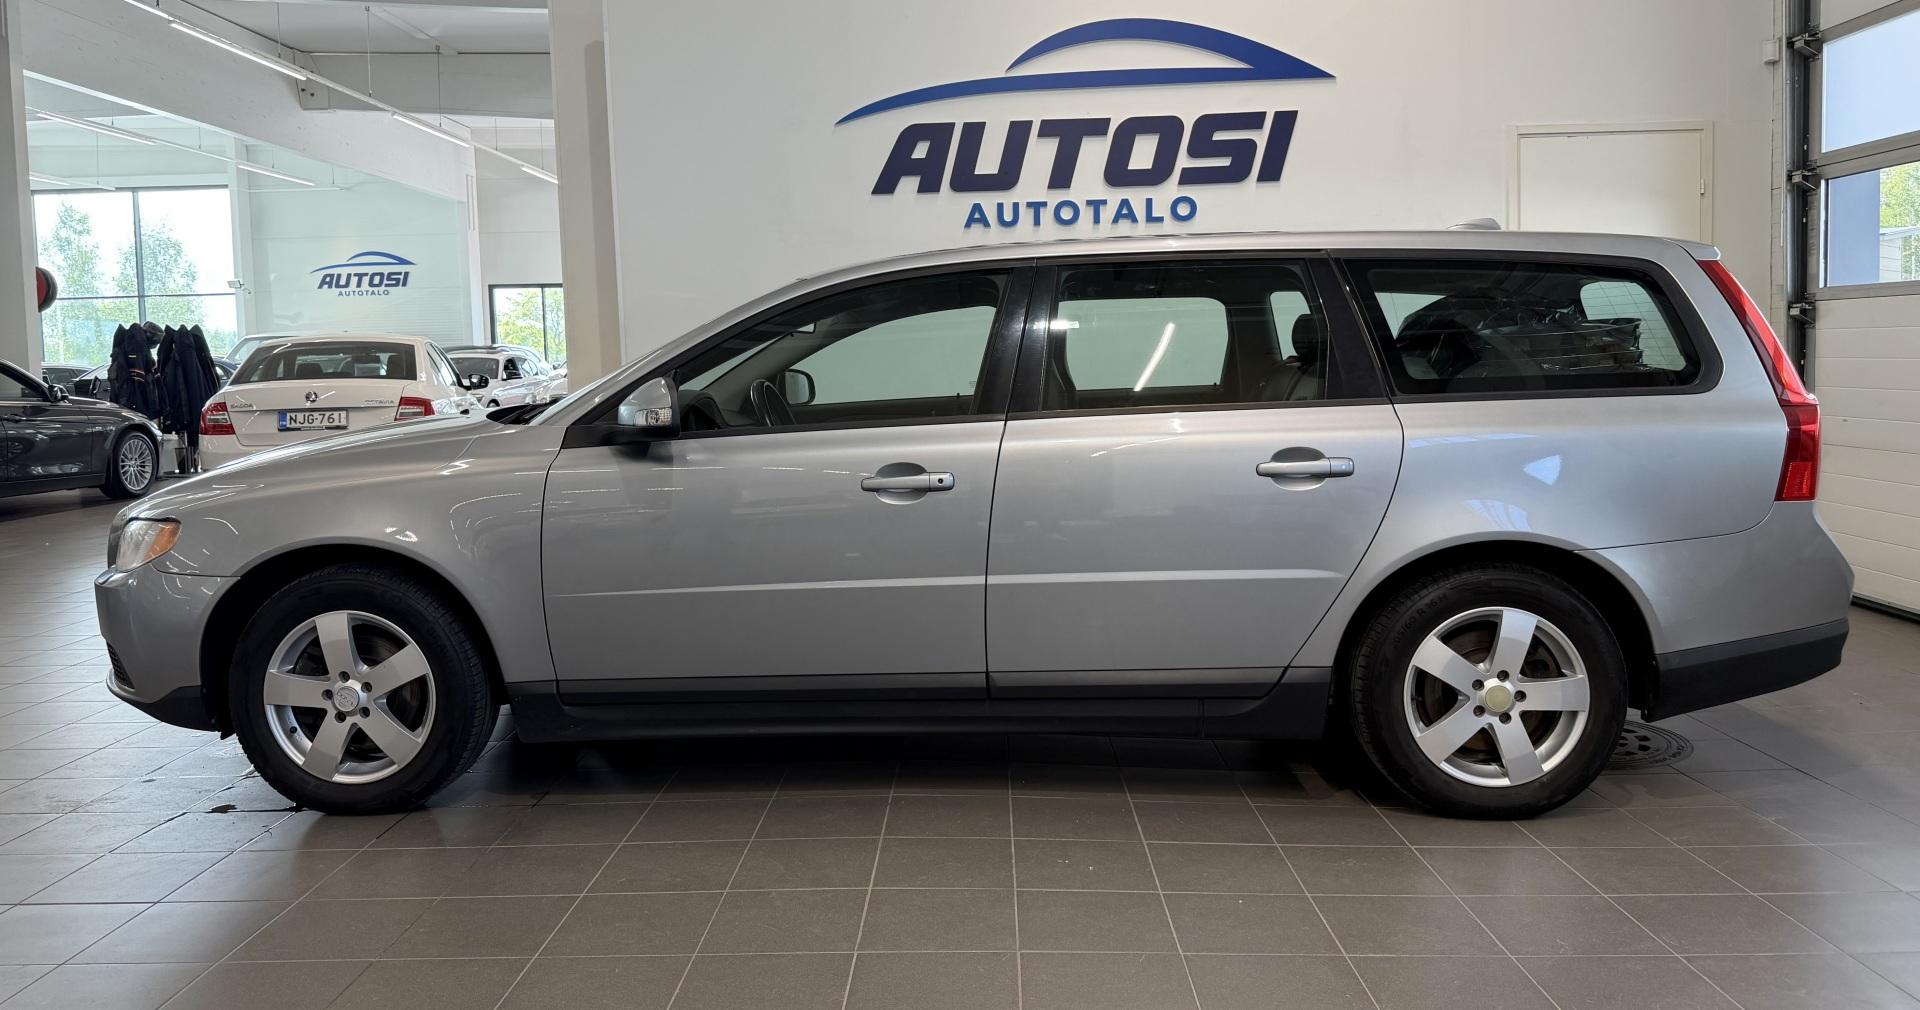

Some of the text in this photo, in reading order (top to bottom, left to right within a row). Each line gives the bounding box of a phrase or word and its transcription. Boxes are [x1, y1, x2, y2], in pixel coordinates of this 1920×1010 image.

[871, 110, 1299, 195] AUTOSI
[963, 196, 1198, 229] AUTOTALO
[317, 271, 410, 289] AUTOSI
[337, 289, 390, 297] AUTOTALO
[289, 412, 342, 425] NJG-761
